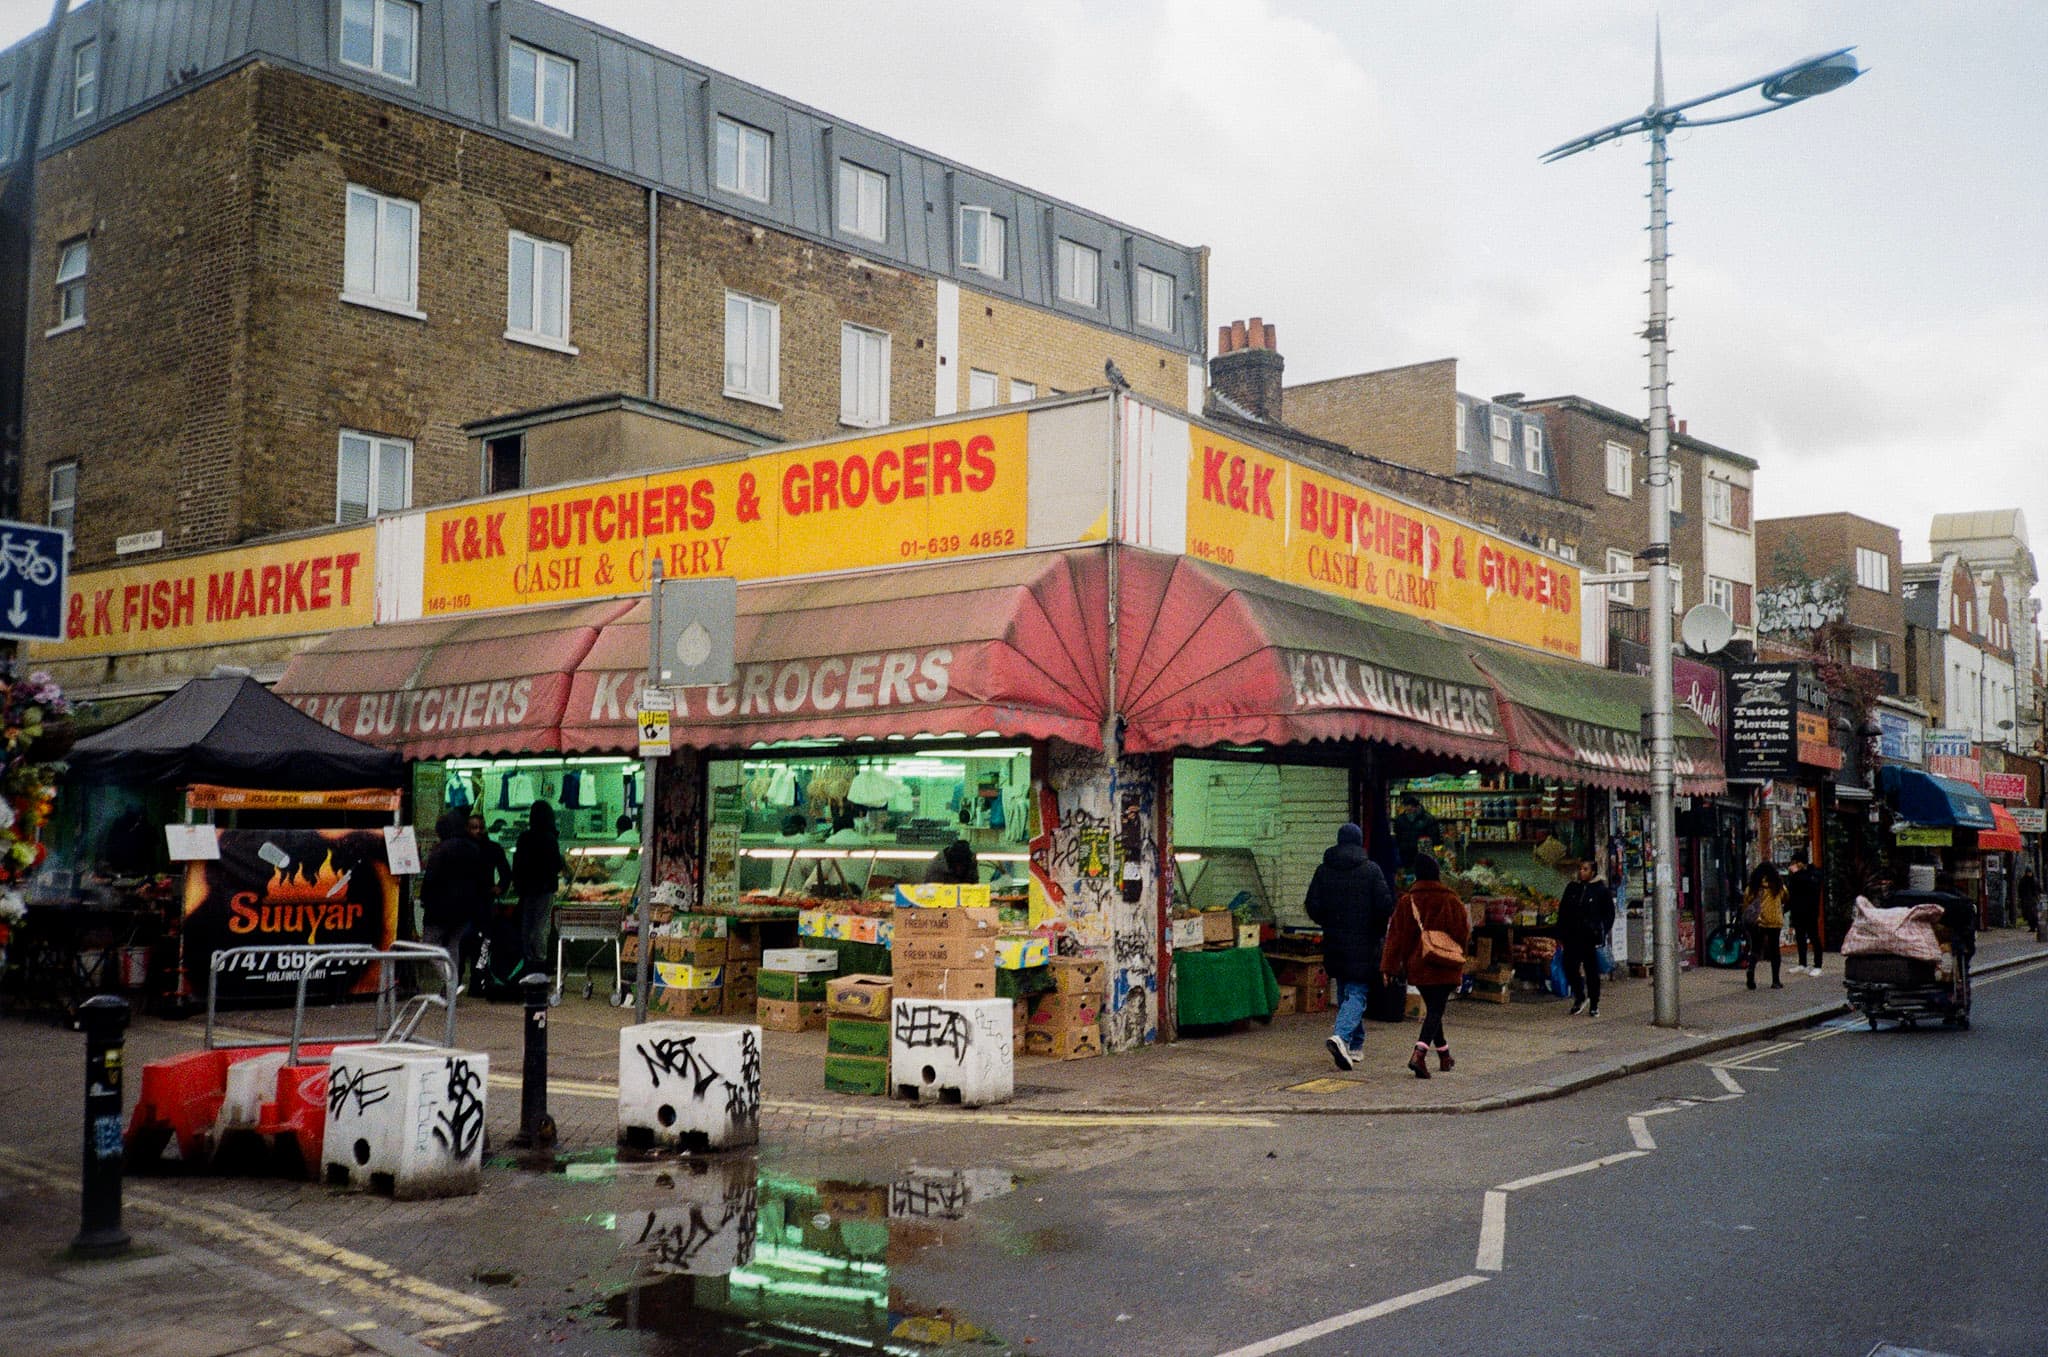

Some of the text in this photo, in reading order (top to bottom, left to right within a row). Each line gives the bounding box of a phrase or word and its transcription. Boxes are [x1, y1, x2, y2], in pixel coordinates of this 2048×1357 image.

[440, 435, 996, 564] K&K BUTCHERS & GROCERS
[900, 529, 1015, 557] 01-639 4852
[1202, 446, 1572, 614] K&K BUTCHERS & GROCERS
[67, 552, 361, 640] & K FISH MARKET
[513, 556, 581, 594] CASH
[594, 553, 615, 586] &
[1308, 545, 1439, 610] CASH & CARRY
[354, 677, 532, 737] BUTCHERS
[706, 650, 952, 718] GROCERS
[1289, 652, 1495, 735] K&K BUTCHERS
[1679, 680, 1720, 728] Style
[1733, 707, 1789, 716] Tattoo
[1734, 719, 1789, 730] Piercing
[1734, 732, 1789, 740] Gold Teeth
[228, 891, 363, 944] Suuyar
